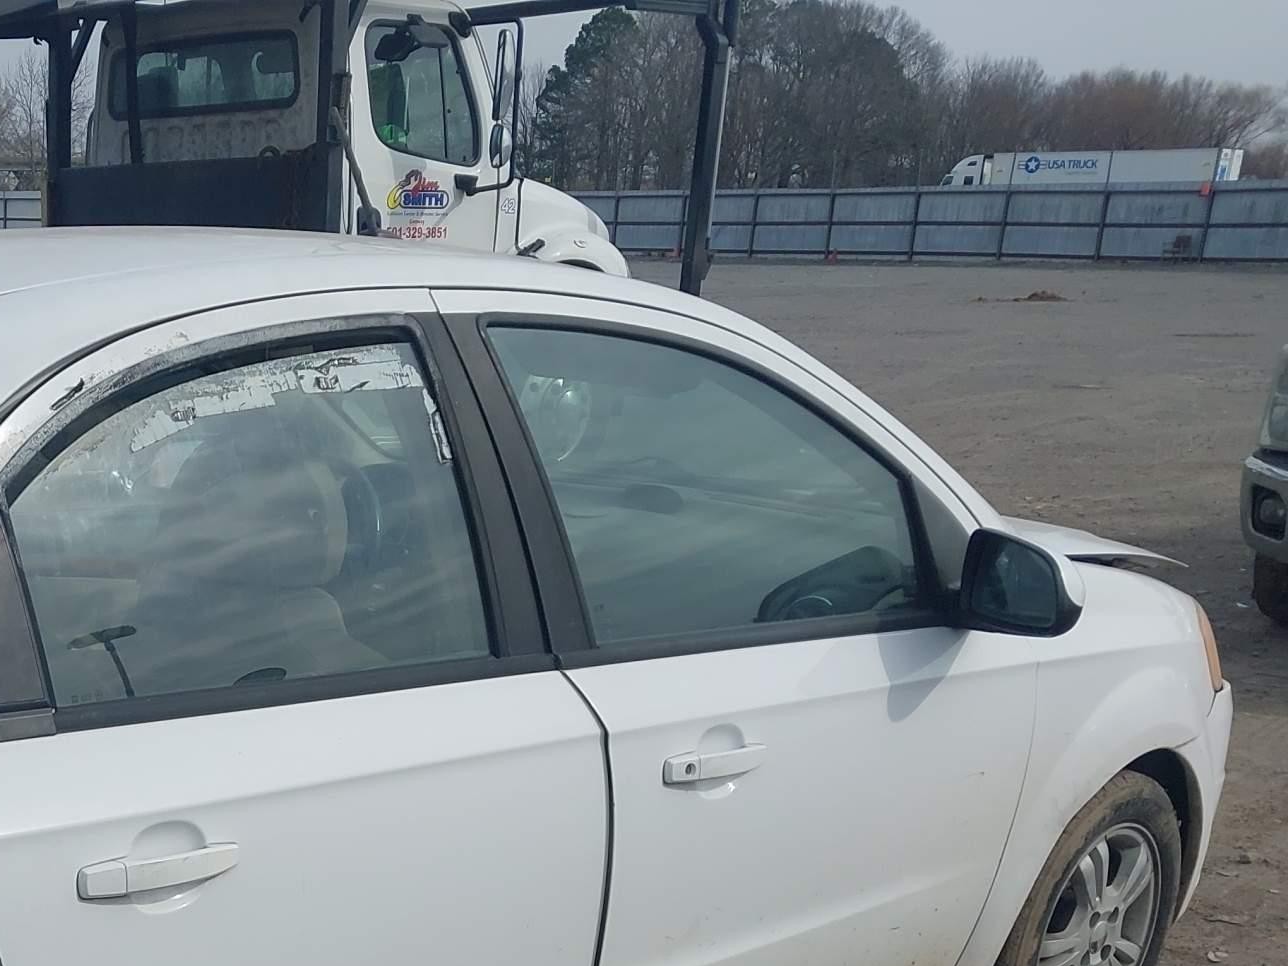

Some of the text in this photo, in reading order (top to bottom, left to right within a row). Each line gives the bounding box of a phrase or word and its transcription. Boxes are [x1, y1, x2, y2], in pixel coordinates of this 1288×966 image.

[1048, 159, 1098, 169] USA TRUCK
[403, 192, 444, 206] SMITH
[501, 198, 516, 214] 42
